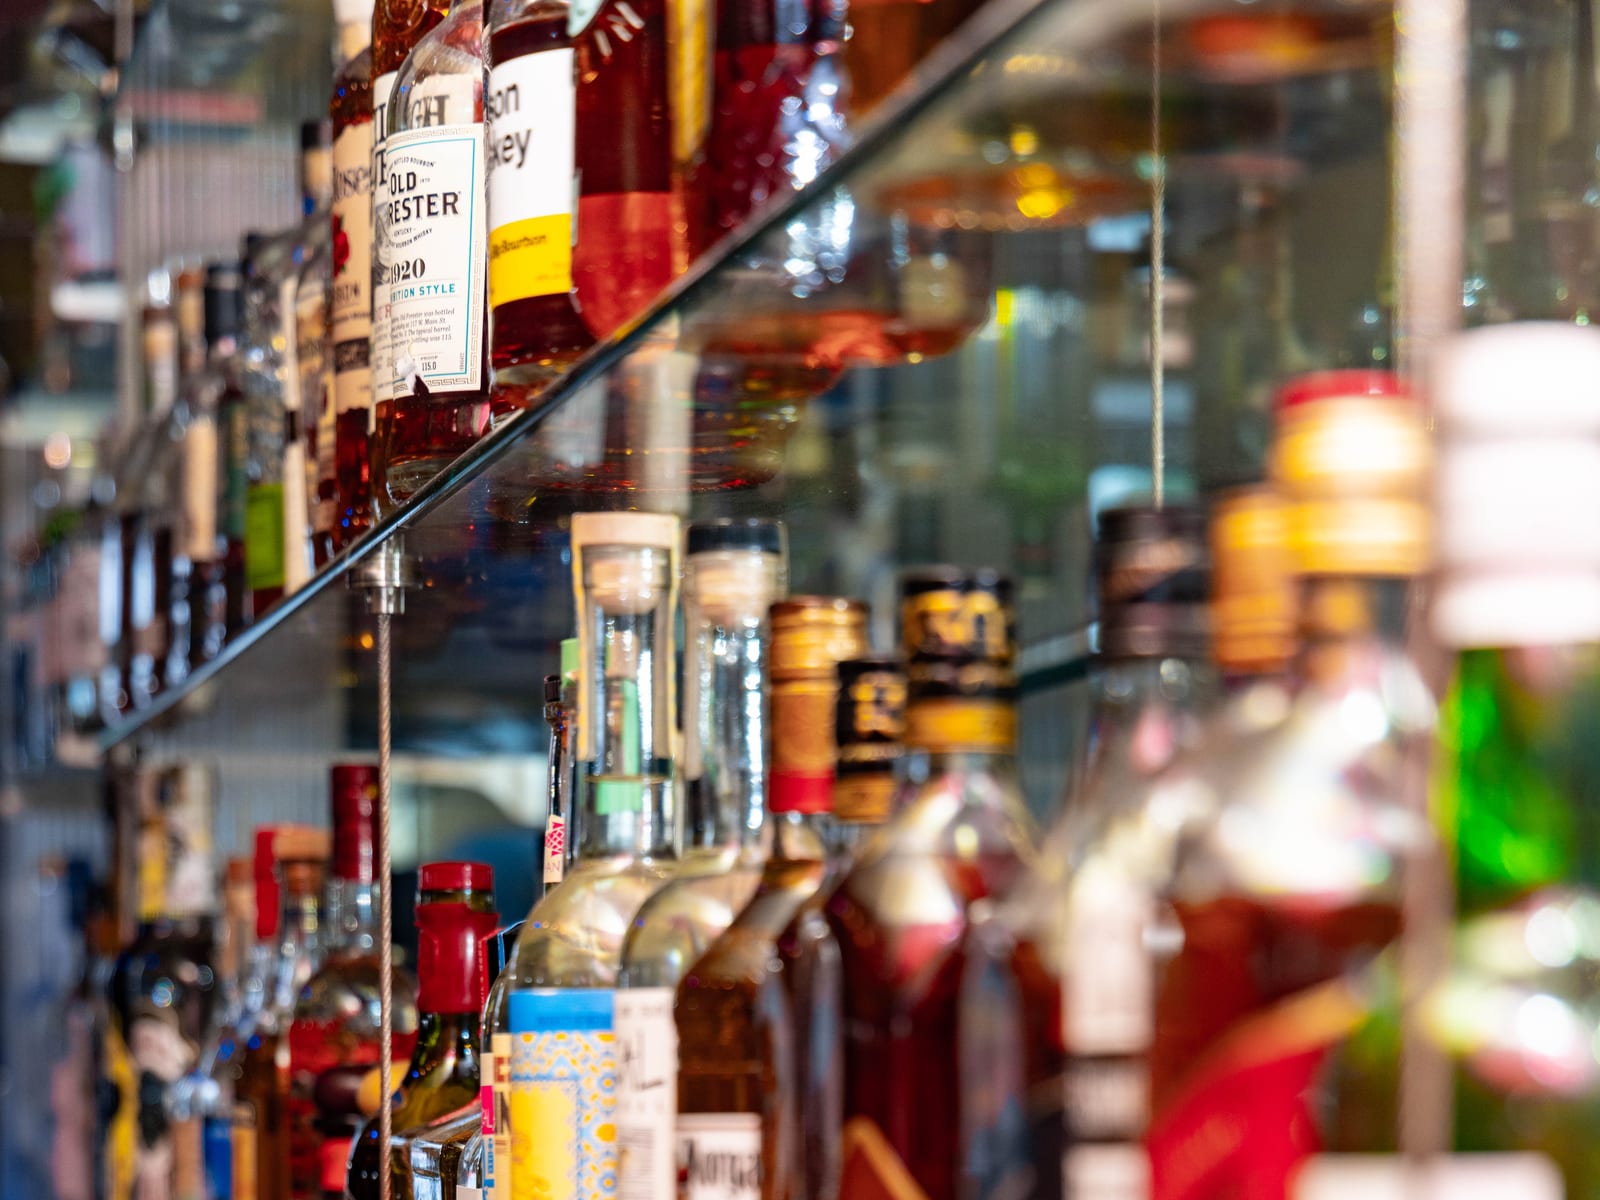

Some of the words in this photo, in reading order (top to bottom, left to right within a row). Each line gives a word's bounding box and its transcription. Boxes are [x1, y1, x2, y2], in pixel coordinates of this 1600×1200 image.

[390, 171, 417, 196] OLD
[390, 257, 426, 285] 1920
[419, 283, 456, 296] STYLE
